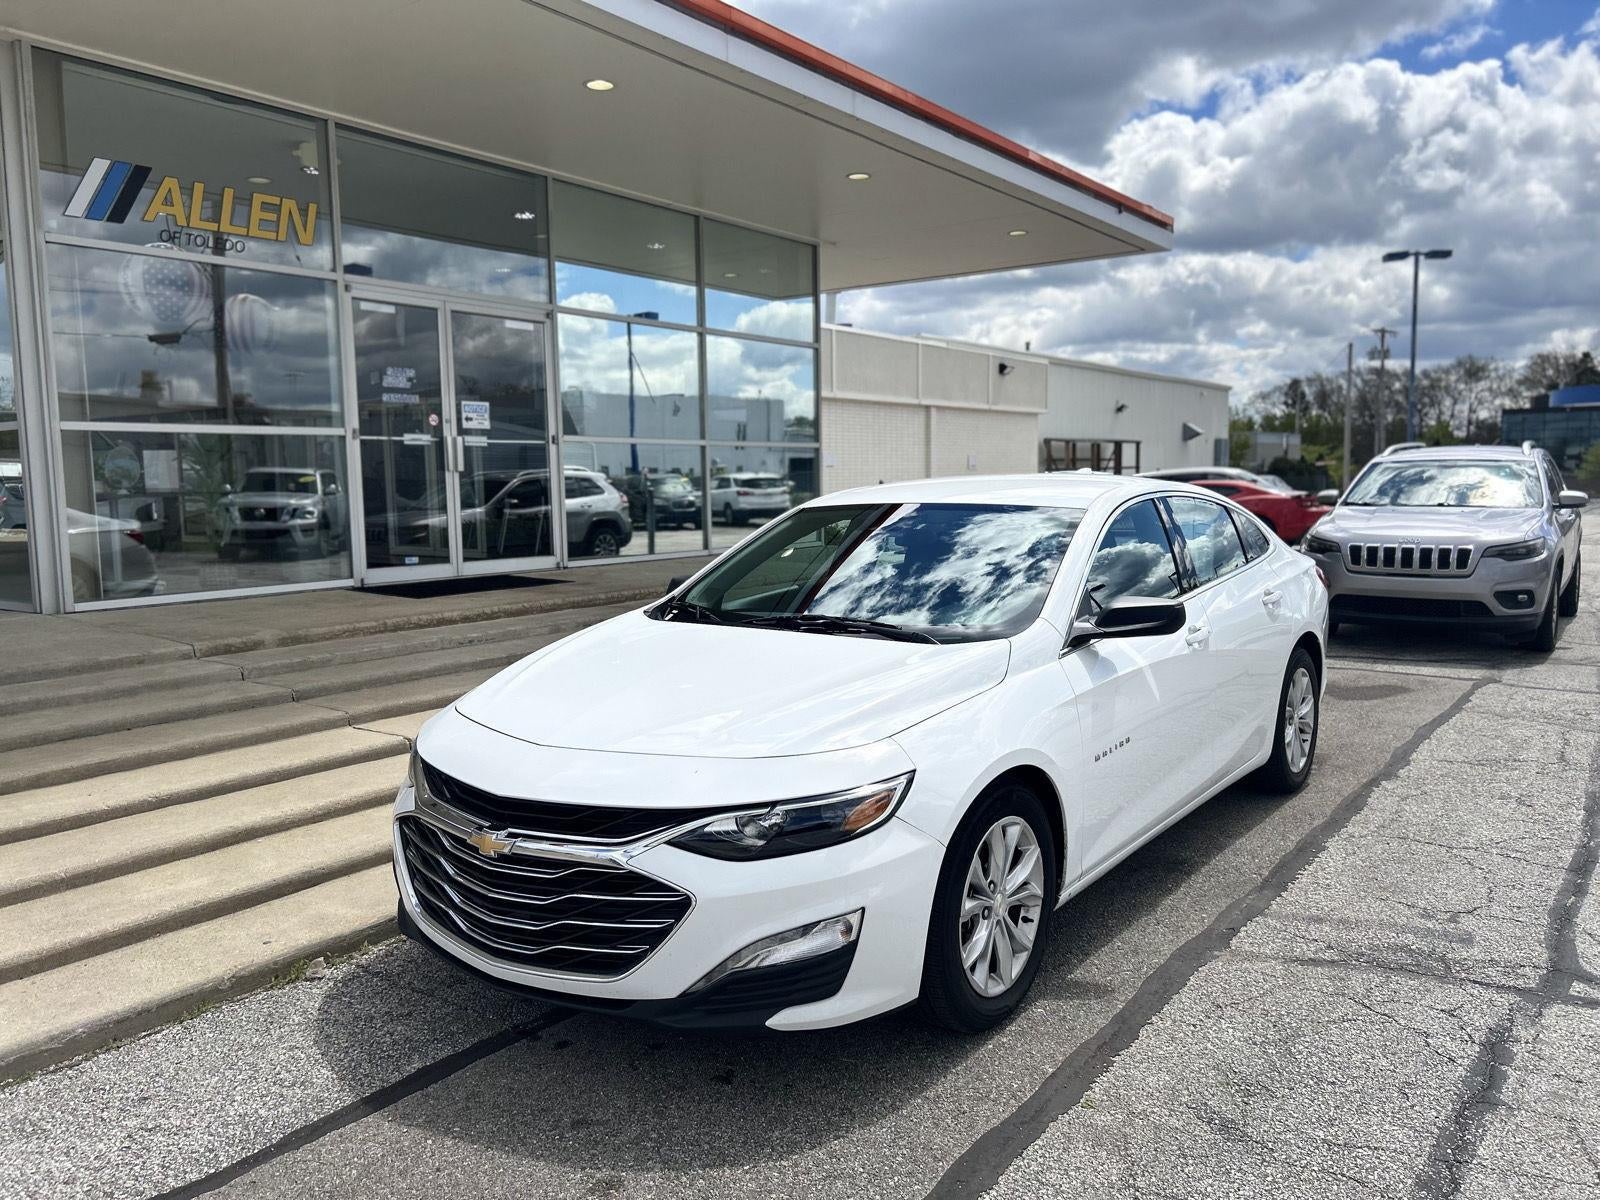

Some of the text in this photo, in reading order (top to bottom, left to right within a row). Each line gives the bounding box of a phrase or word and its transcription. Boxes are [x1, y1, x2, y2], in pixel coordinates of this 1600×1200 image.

[143, 175, 318, 247] ALLEN
[159, 228, 246, 253] OF TOLEDO
[464, 404, 487, 414] NOTICE
